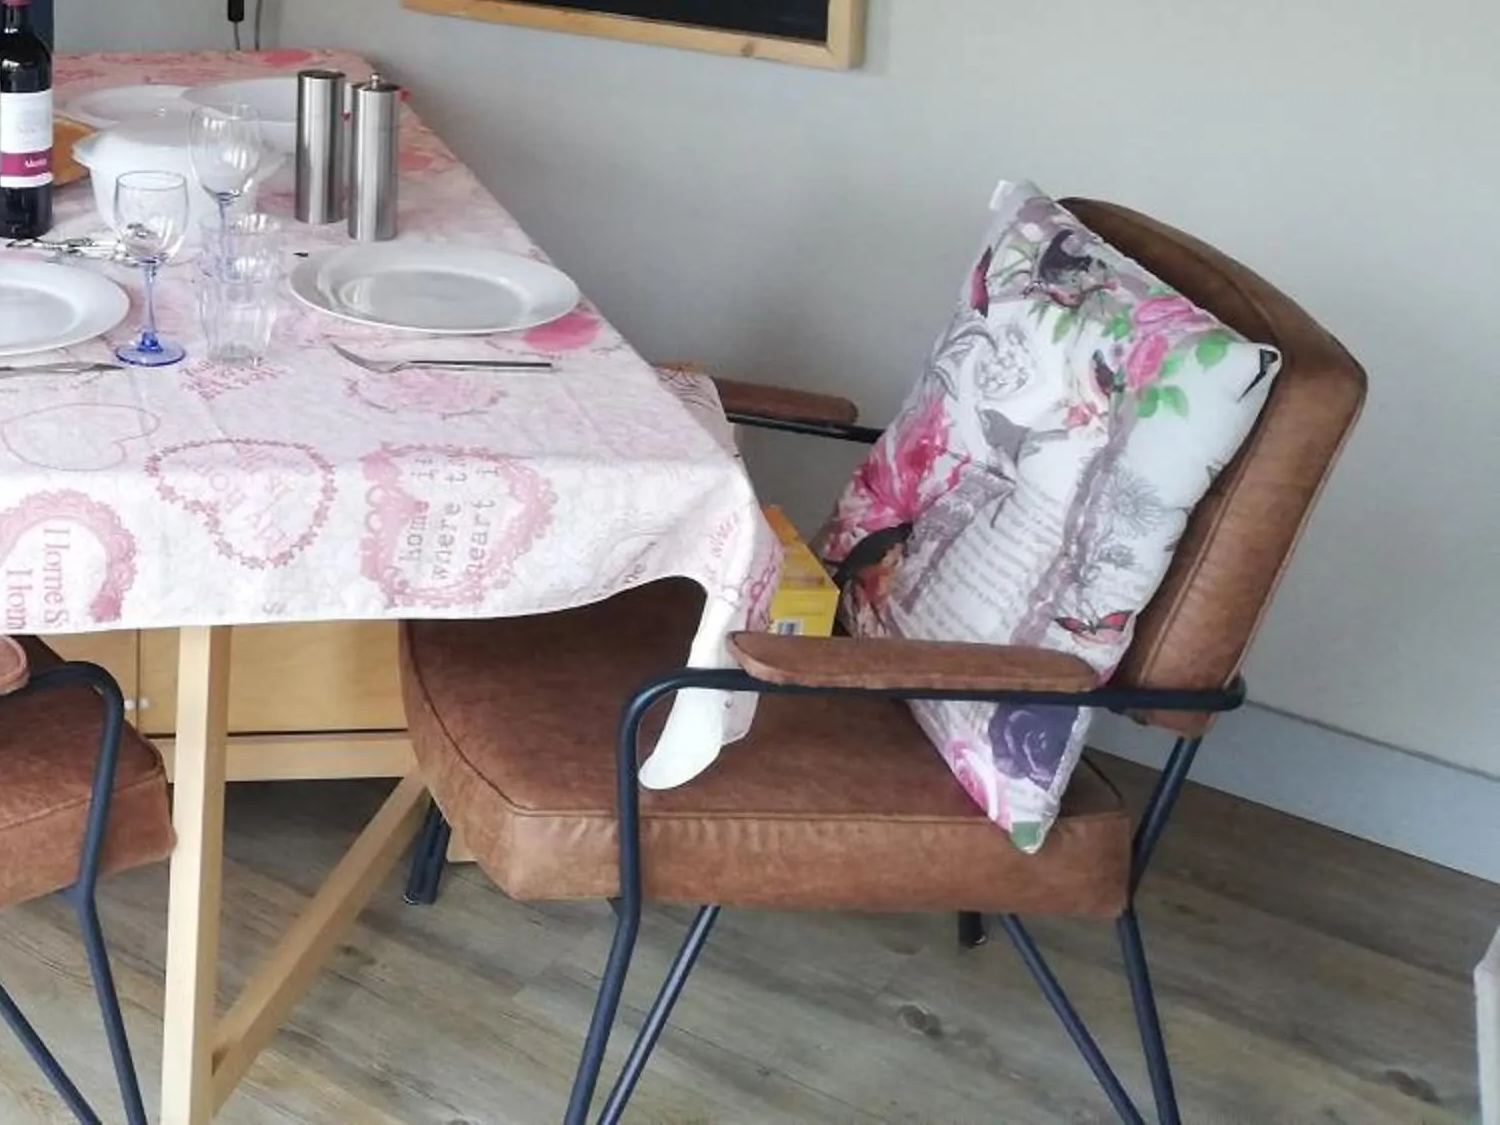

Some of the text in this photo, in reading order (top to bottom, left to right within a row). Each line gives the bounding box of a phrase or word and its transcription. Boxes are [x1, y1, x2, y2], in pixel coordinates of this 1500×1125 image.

[6, 568, 34, 630] Hom
[42, 527, 72, 628] Home S
